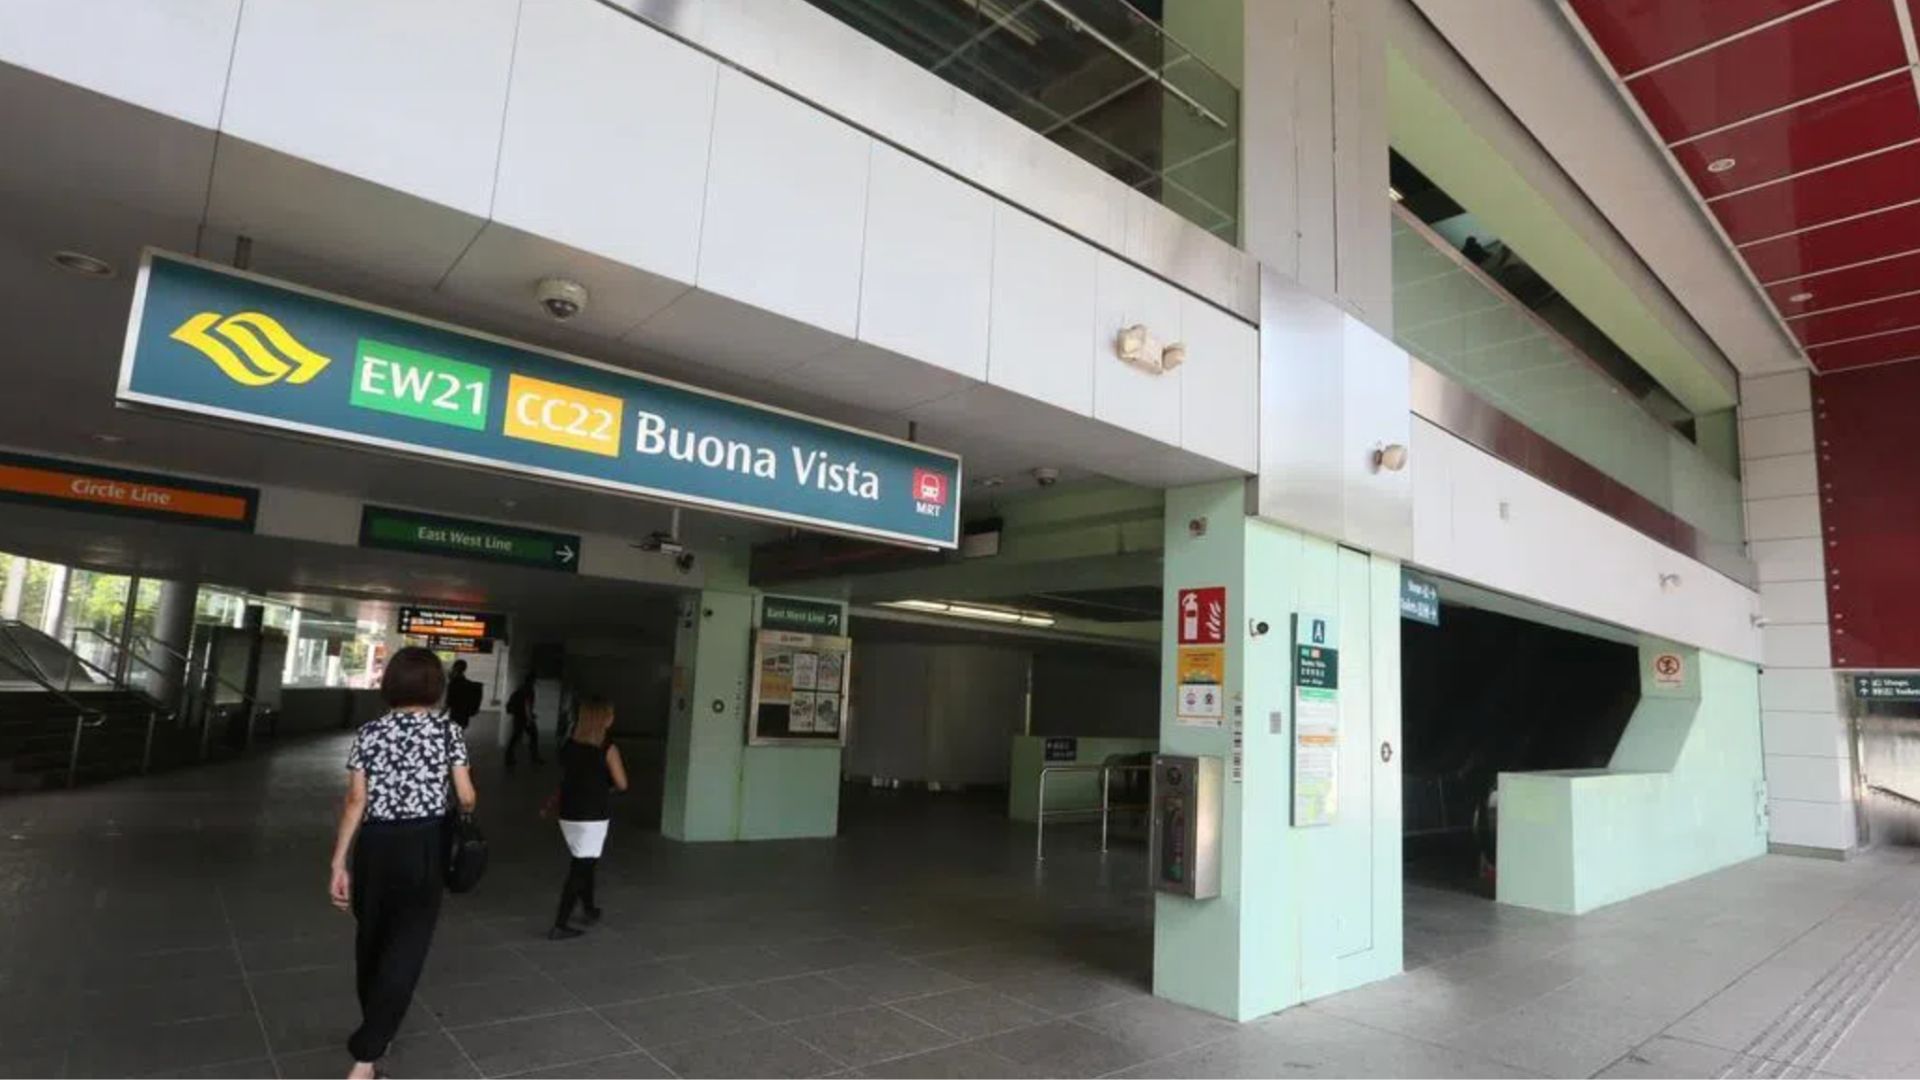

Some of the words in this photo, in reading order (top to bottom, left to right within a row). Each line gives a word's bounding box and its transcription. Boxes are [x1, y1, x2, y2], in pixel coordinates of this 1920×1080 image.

[360, 355, 484, 416] EW21
[516, 392, 613, 442] CC22
[635, 410, 777, 480] Buona
[791, 446, 880, 501] Vista
[71, 478, 125, 500] Circle
[130, 486, 171, 505] Line
[915, 501, 942, 518] MRT
[417, 525, 446, 542] East
[449, 531, 482, 548] West
[485, 536, 513, 552] Line
[1314, 621, 1324, 642] A
